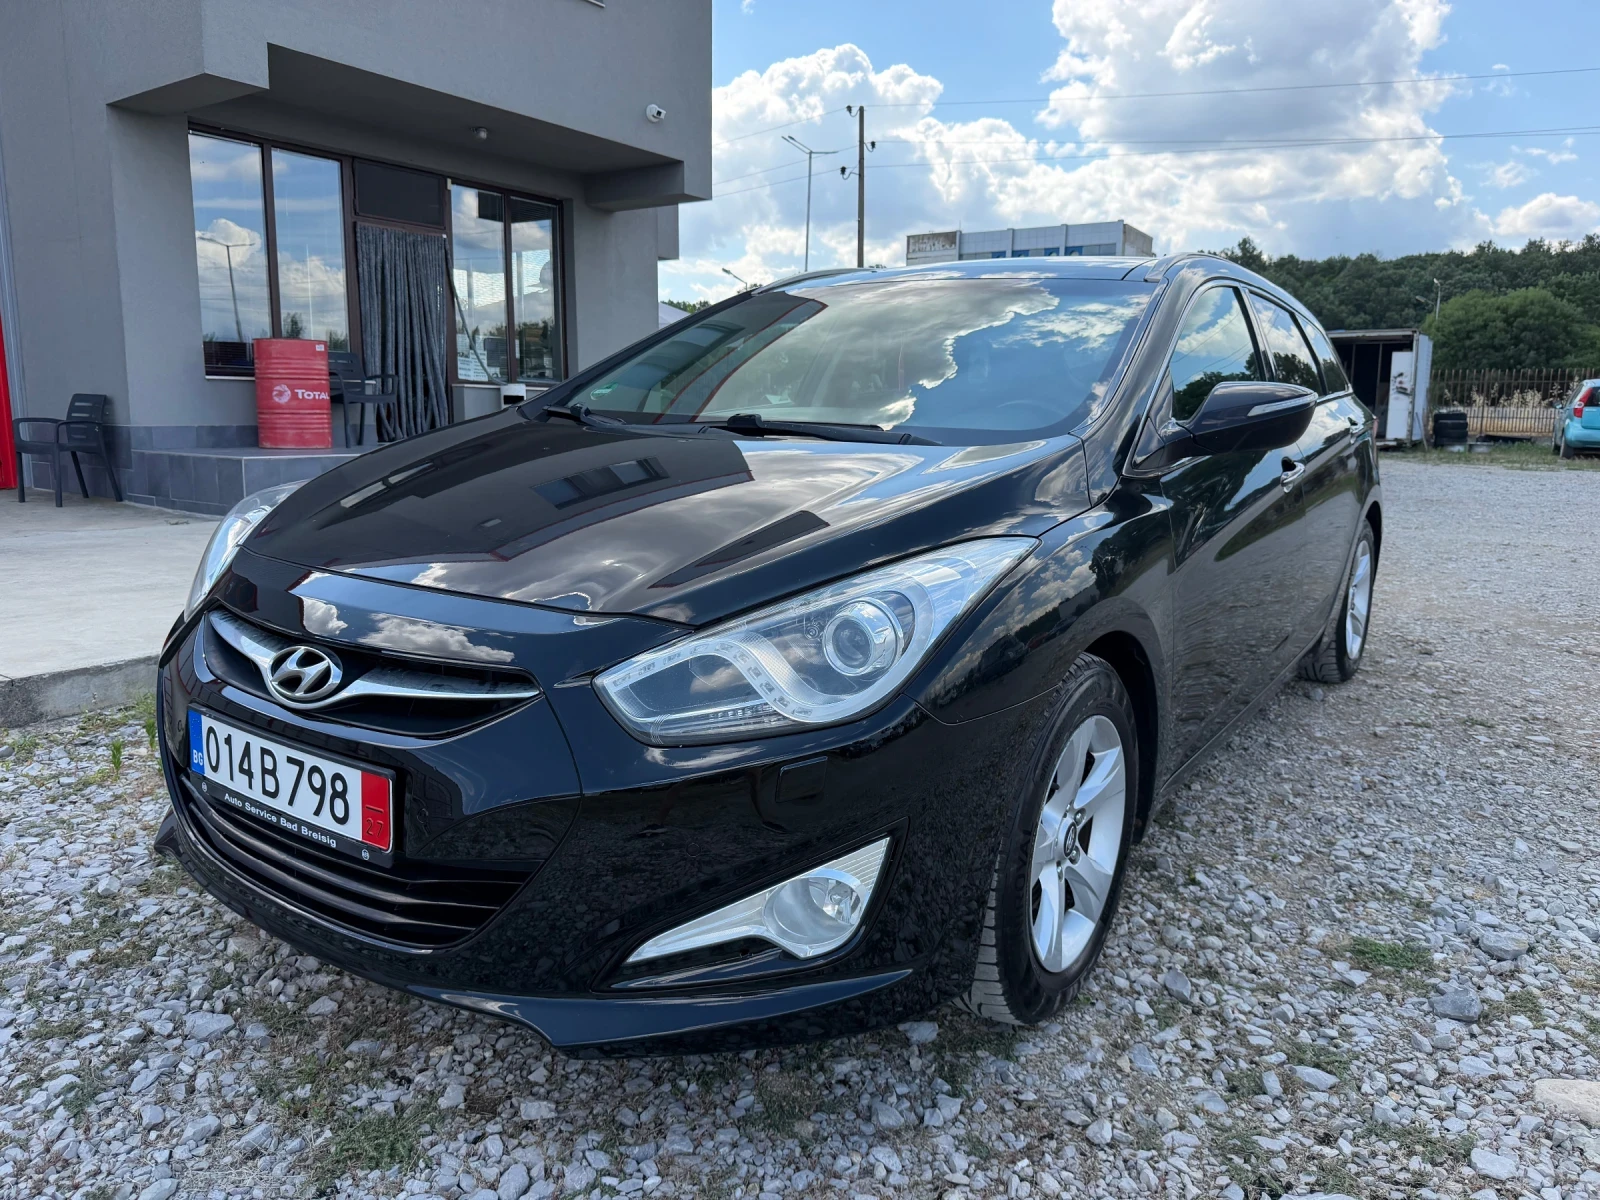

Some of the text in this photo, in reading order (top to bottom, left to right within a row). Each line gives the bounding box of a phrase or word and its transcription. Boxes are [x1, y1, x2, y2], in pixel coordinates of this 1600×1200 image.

[295, 389, 330, 400] TOTAL
[193, 750, 204, 766] BG
[205, 725, 350, 826] 014B798
[224, 793, 336, 848] Auto Service Bad Breisig
[366, 818, 384, 838] 27
